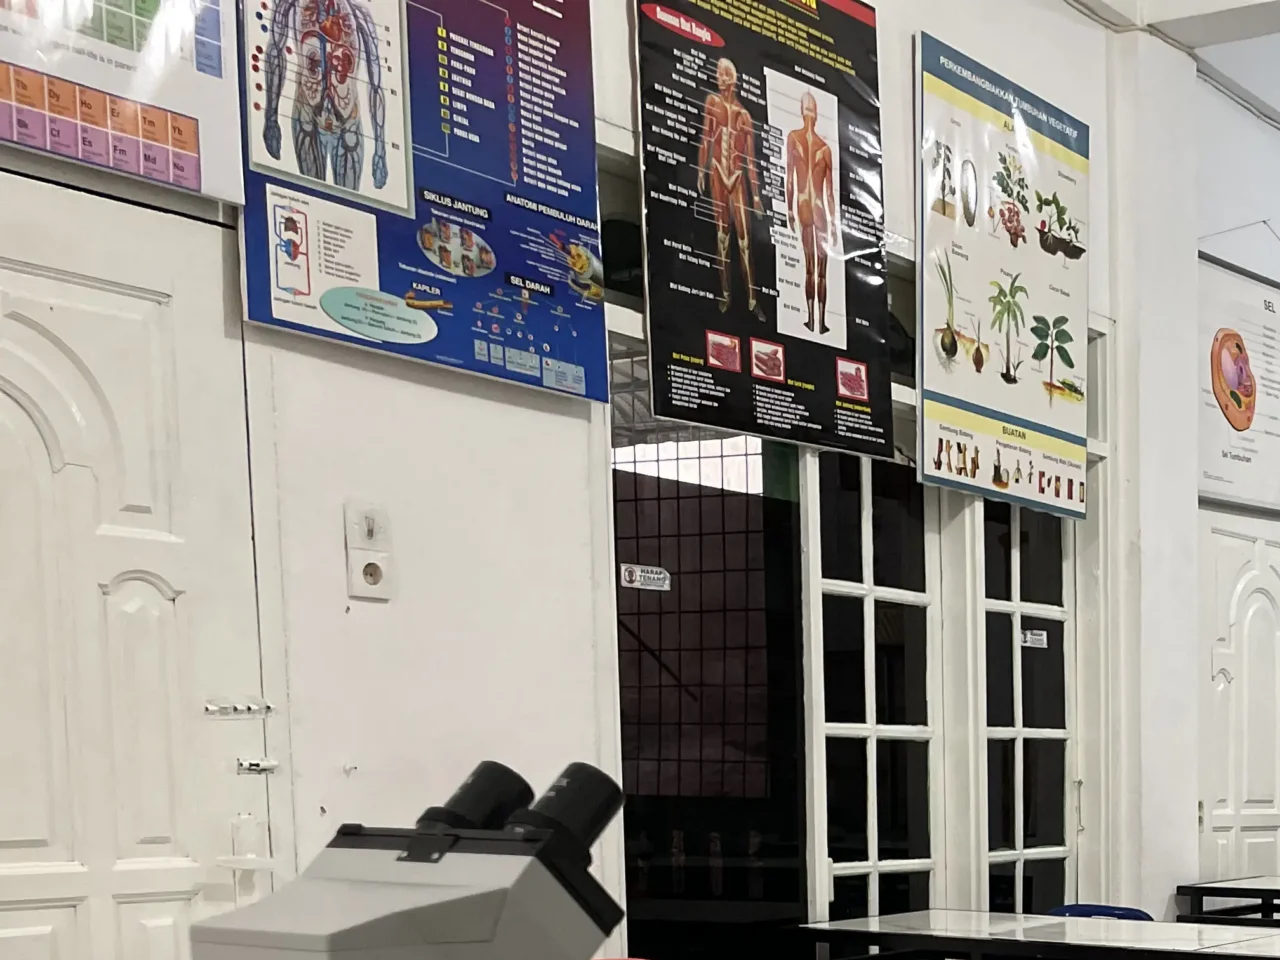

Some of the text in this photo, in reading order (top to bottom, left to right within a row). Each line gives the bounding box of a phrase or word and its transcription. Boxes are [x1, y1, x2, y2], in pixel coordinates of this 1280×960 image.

[939, 55, 1015, 104] PERKEMBANGBIAKKAN
[1048, 113, 1078, 139] VEGETATIF
[80, 99, 92, 111] Ho
[142, 116, 156, 128] Tm
[172, 125, 183, 137] Yb
[82, 136, 93, 148] Es
[113, 145, 127, 157] Fm
[144, 153, 157, 166] Md
[423, 190, 489, 219] SIKLUS JANTUNG
[506, 193, 538, 212] ANATOMI
[538, 204, 576, 224] PEMBULUH
[412, 281, 441, 296] KAPILER
[510, 275, 551, 295] SEL DARAH
[1263, 299, 1277, 314] SEL
[1002, 425, 1027, 440] BUATAN
[1221, 449, 1252, 464] Sel Tumbuhan
[639, 574, 667, 582] TENANG
[640, 568, 663, 576] HARAP
